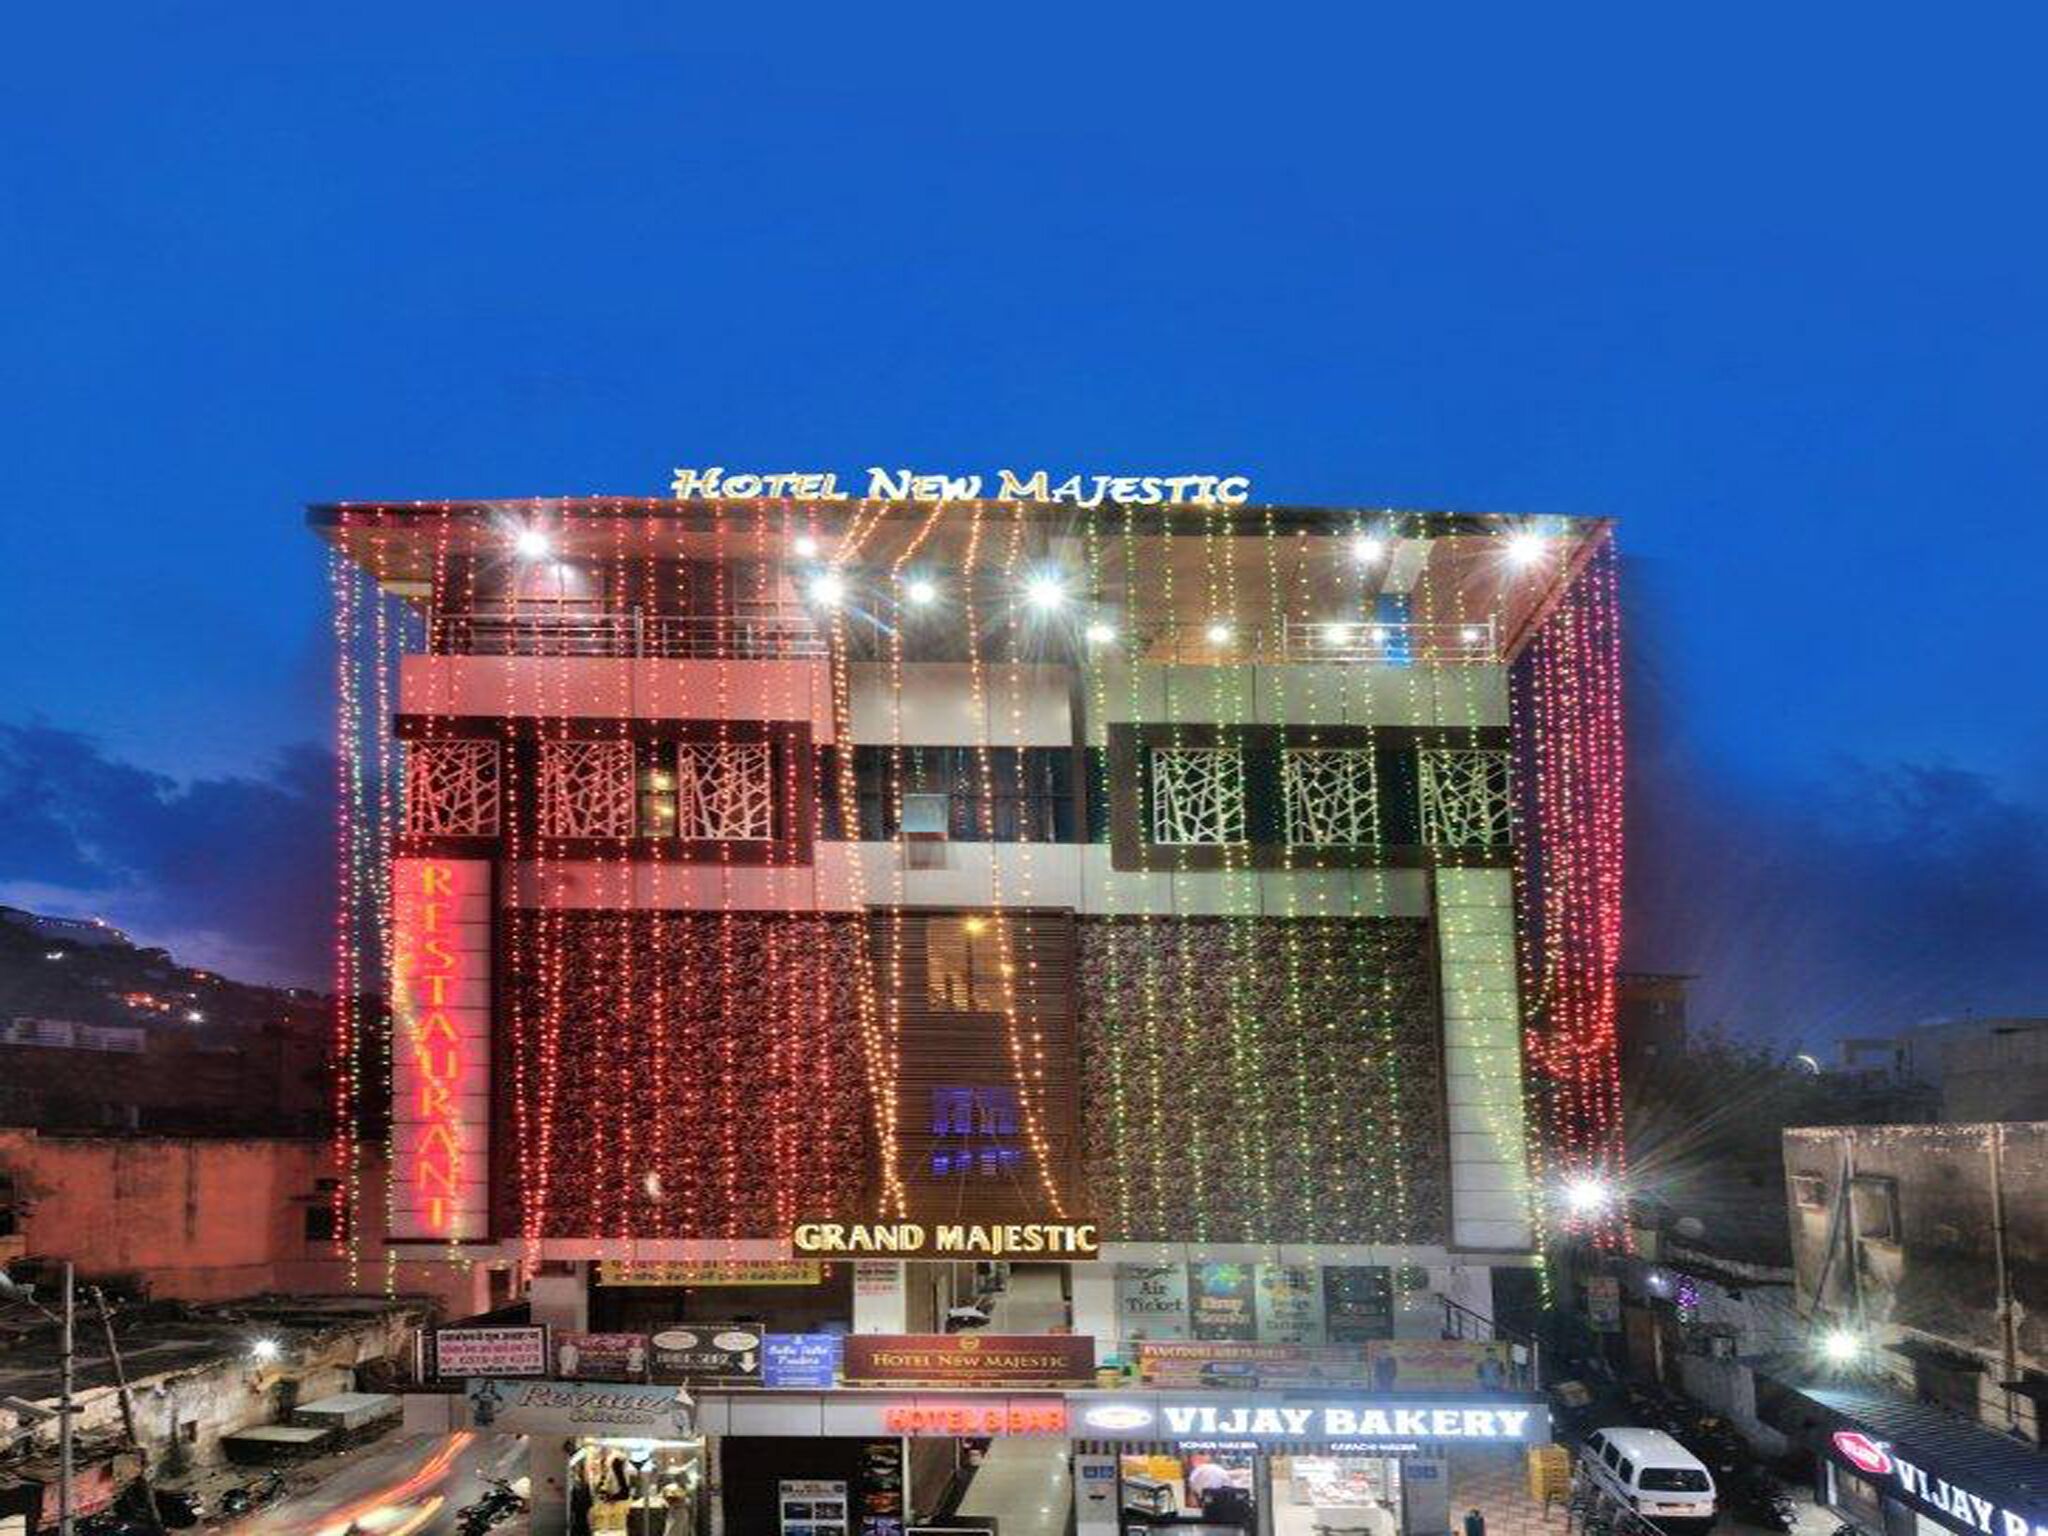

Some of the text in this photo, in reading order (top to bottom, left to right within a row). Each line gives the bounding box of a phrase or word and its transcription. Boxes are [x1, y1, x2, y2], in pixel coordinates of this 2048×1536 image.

[671, 466, 1250, 509] HOTEL NEW MAJESTIC
[794, 1223, 1099, 1256] GRAND MAJESTIC
[872, 1352, 1069, 1368] HOTEL NEW MAJESTIC
[887, 1406, 978, 1433] HOTEL
[1007, 1407, 1066, 1433] BAR
[1164, 1407, 1313, 1435] VIJAY
[1324, 1408, 1529, 1437] BAKERY
[1894, 1457, 1995, 1535] VIJAY
